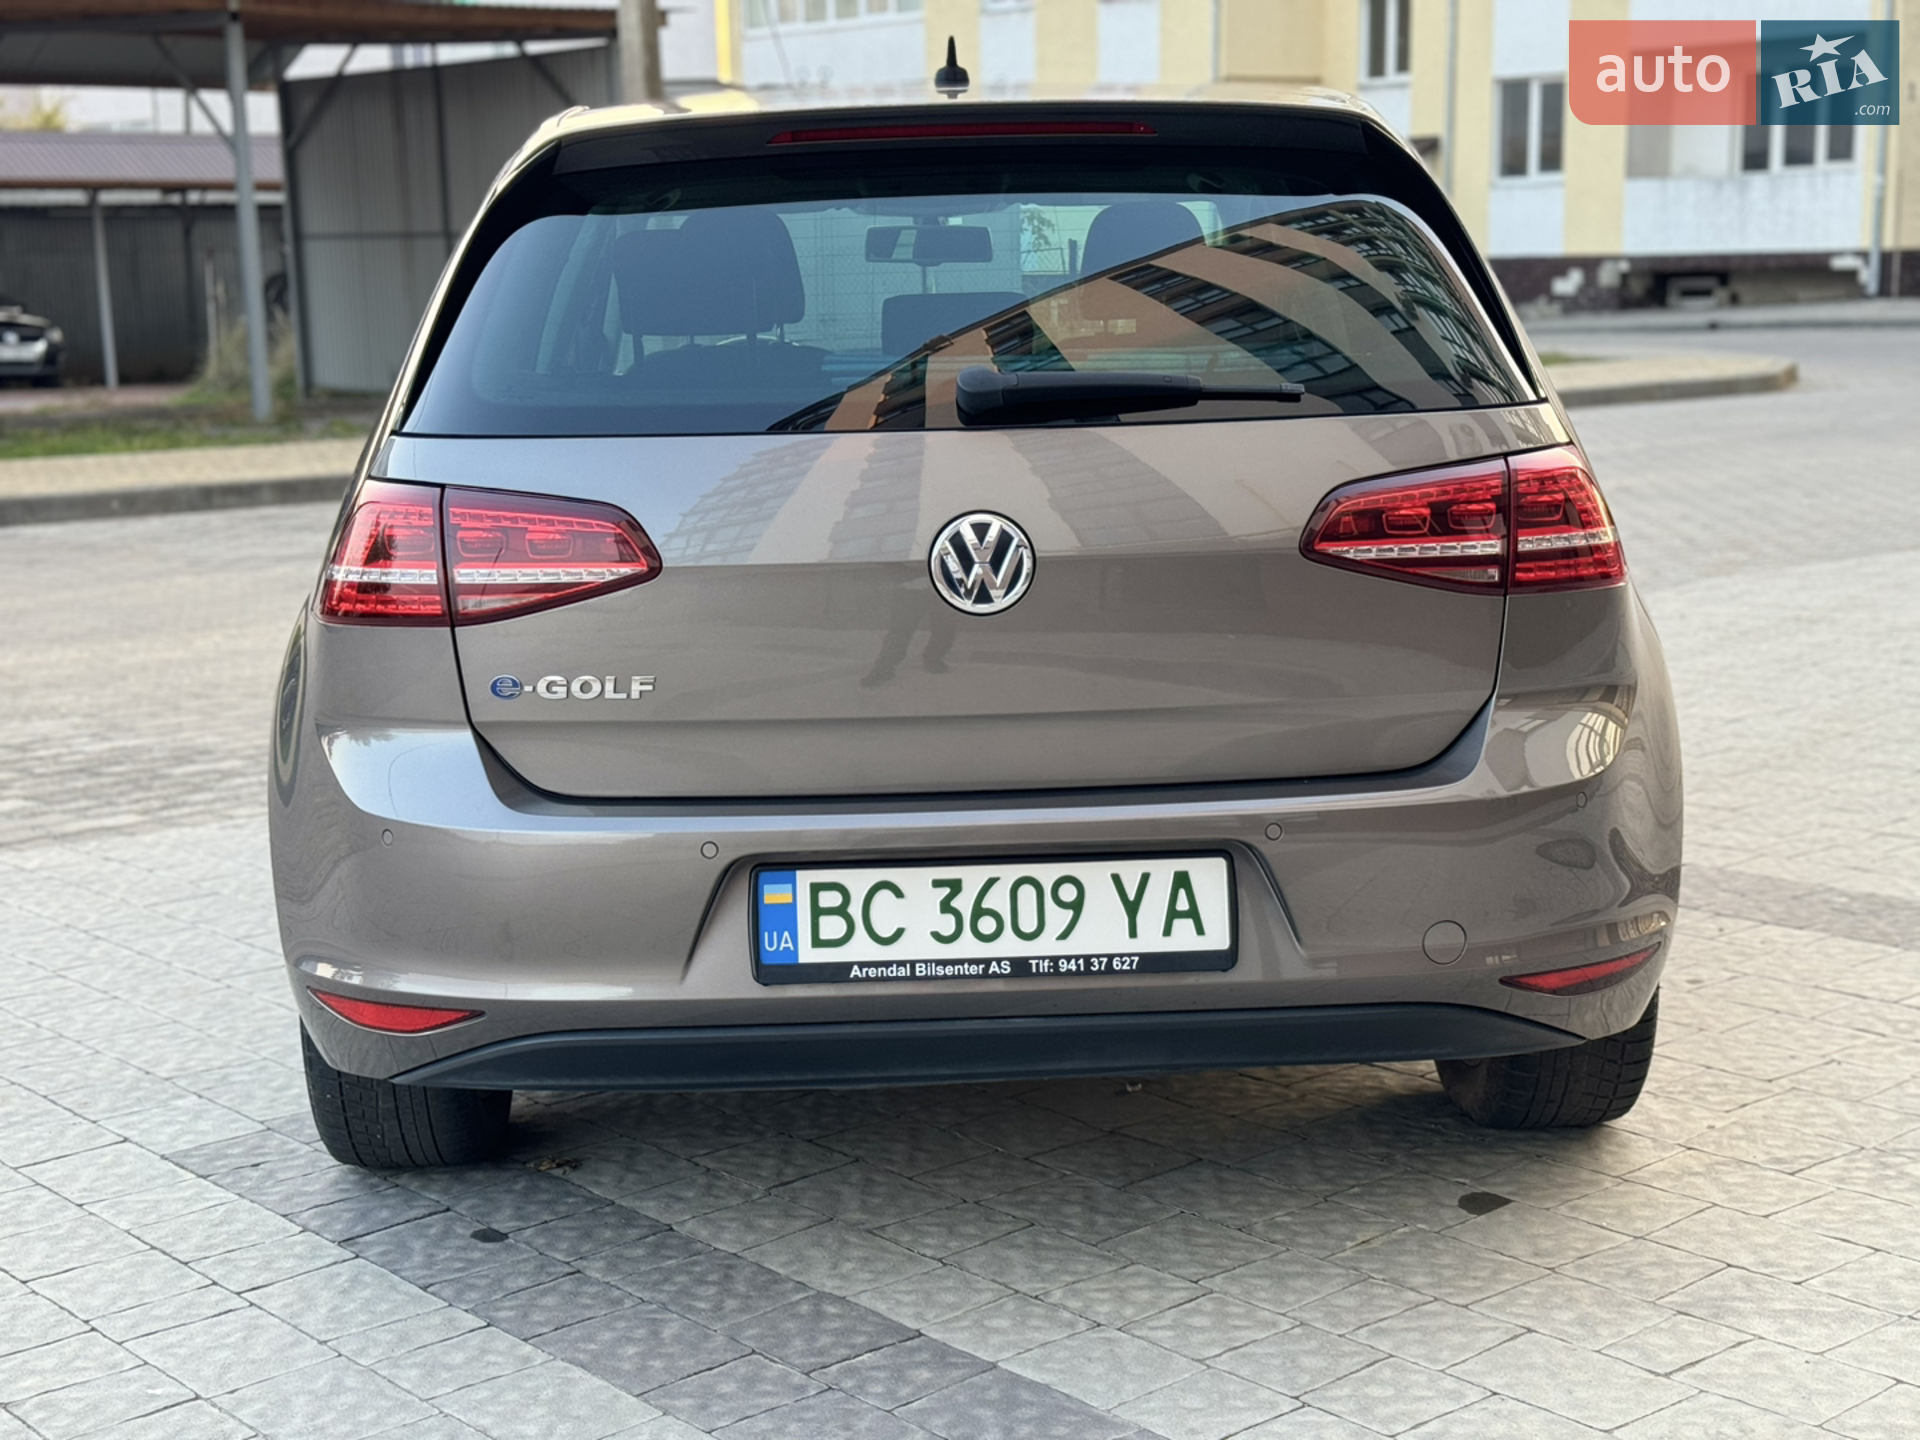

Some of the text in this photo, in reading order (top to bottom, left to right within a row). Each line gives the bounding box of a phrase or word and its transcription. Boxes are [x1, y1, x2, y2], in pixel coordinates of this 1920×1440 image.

[489, 674, 656, 700] e-GOLF
[809, 870, 1206, 949] BC 3609 YA
[764, 930, 794, 952] UA
[849, 956, 1140, 978] Arendal Bilsenter AS Tlf: 941 37 627
